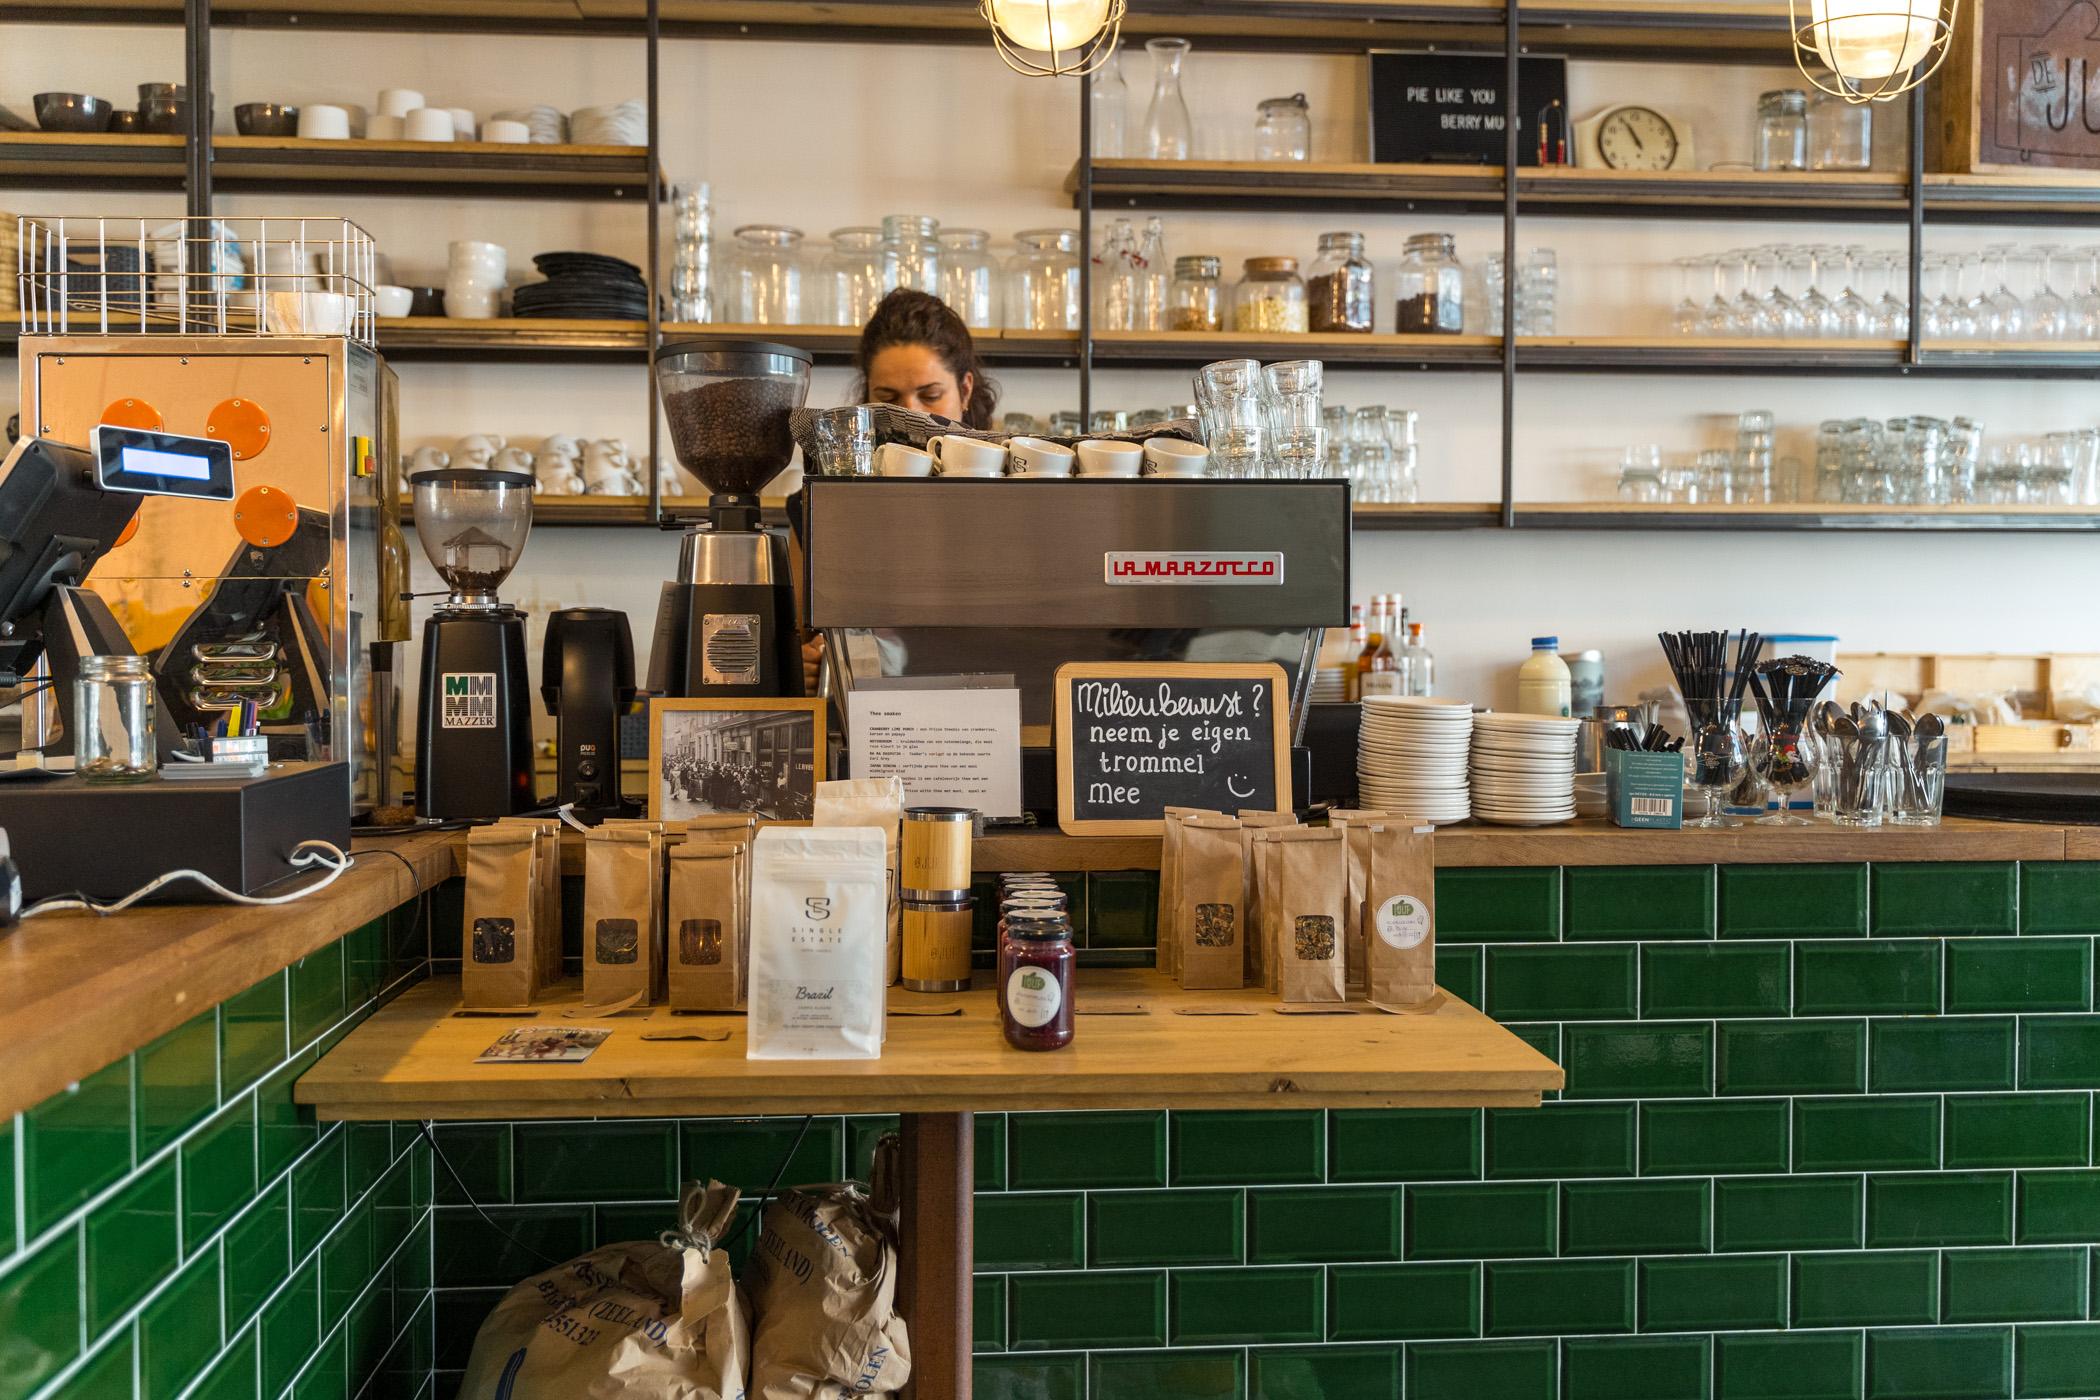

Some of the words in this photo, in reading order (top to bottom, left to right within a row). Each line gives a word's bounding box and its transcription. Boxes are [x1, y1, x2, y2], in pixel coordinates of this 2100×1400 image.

[1406, 86, 1430, 103] PIE
[1435, 88, 1465, 104] LIKE
[1469, 88, 1496, 105] YOU
[1440, 113, 1482, 130] BERRY
[1089, 724, 1154, 744] neem
[1158, 723, 1180, 750] je
[1191, 720, 1252, 755] eigen
[1099, 751, 1206, 775] trommel
[791, 926, 843, 935] SINGLE
[791, 936, 842, 944] ESTATE
[795, 985, 834, 1001] Brazil
